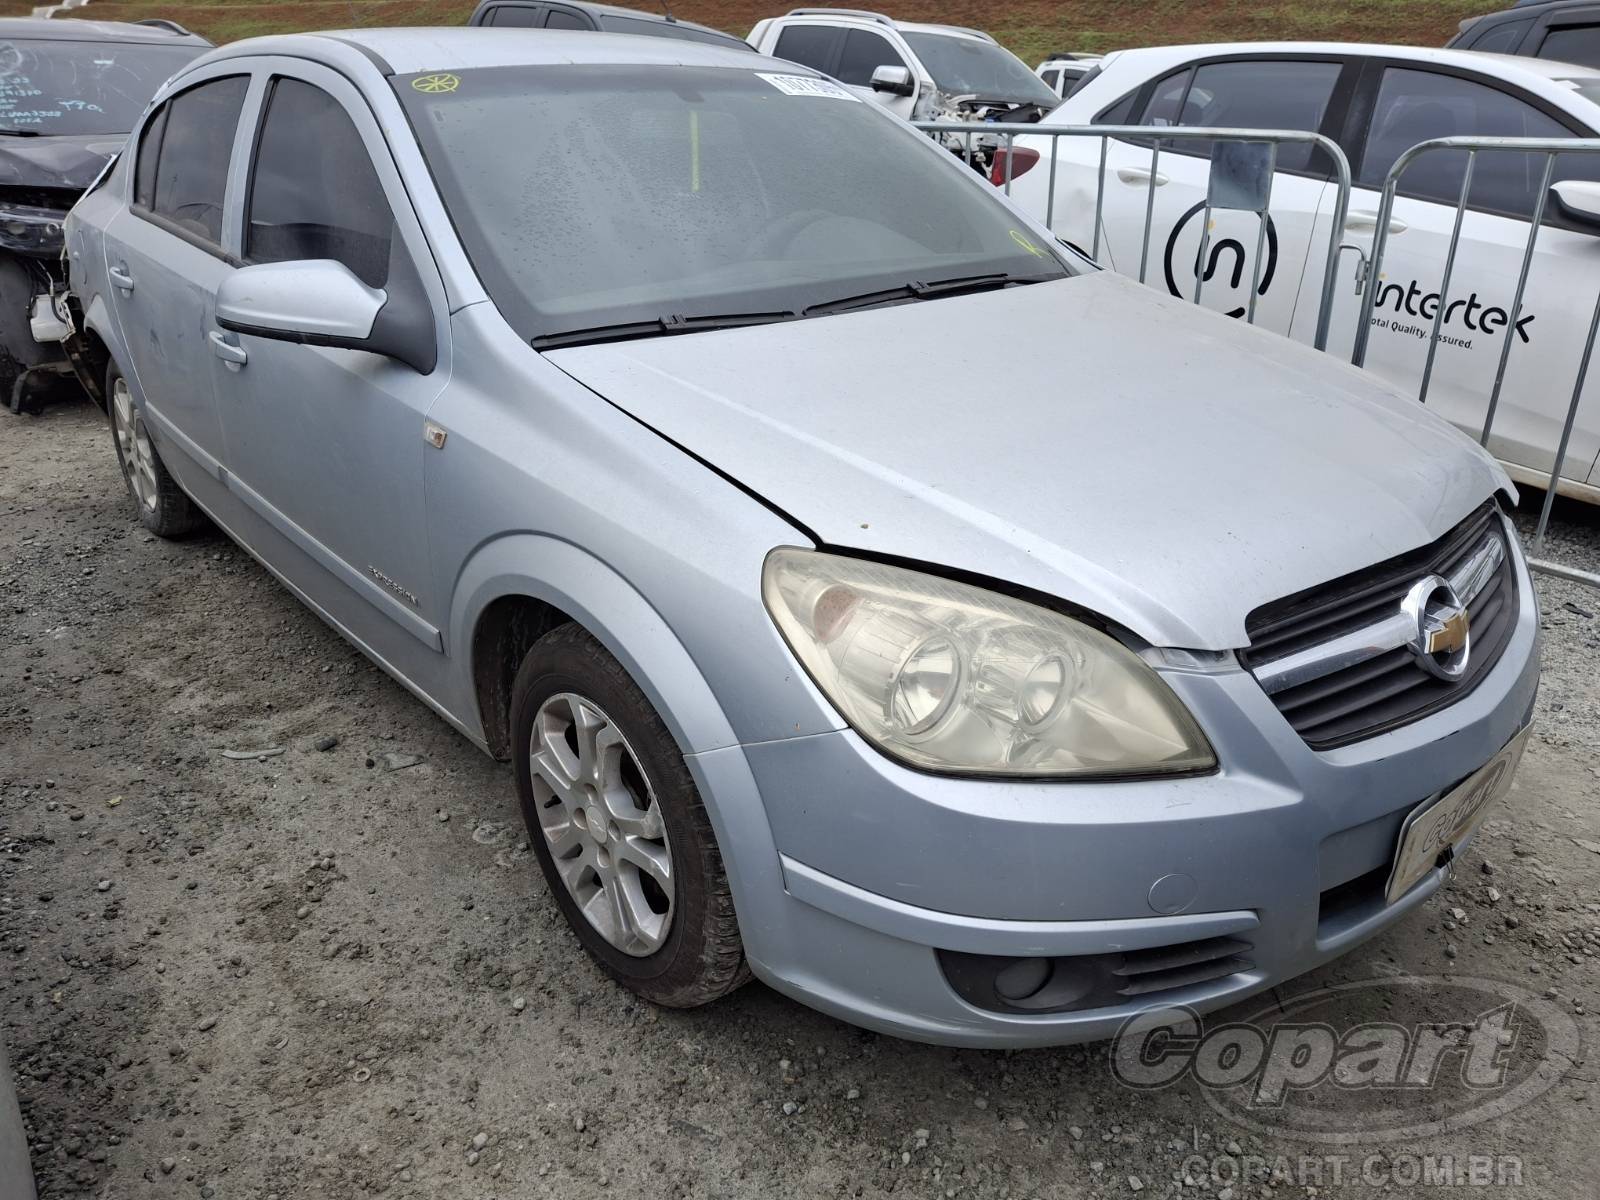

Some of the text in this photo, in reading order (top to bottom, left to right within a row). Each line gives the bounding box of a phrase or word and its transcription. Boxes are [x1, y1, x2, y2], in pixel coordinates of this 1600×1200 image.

[1371, 317, 1473, 350] otal Quality. ssured.
